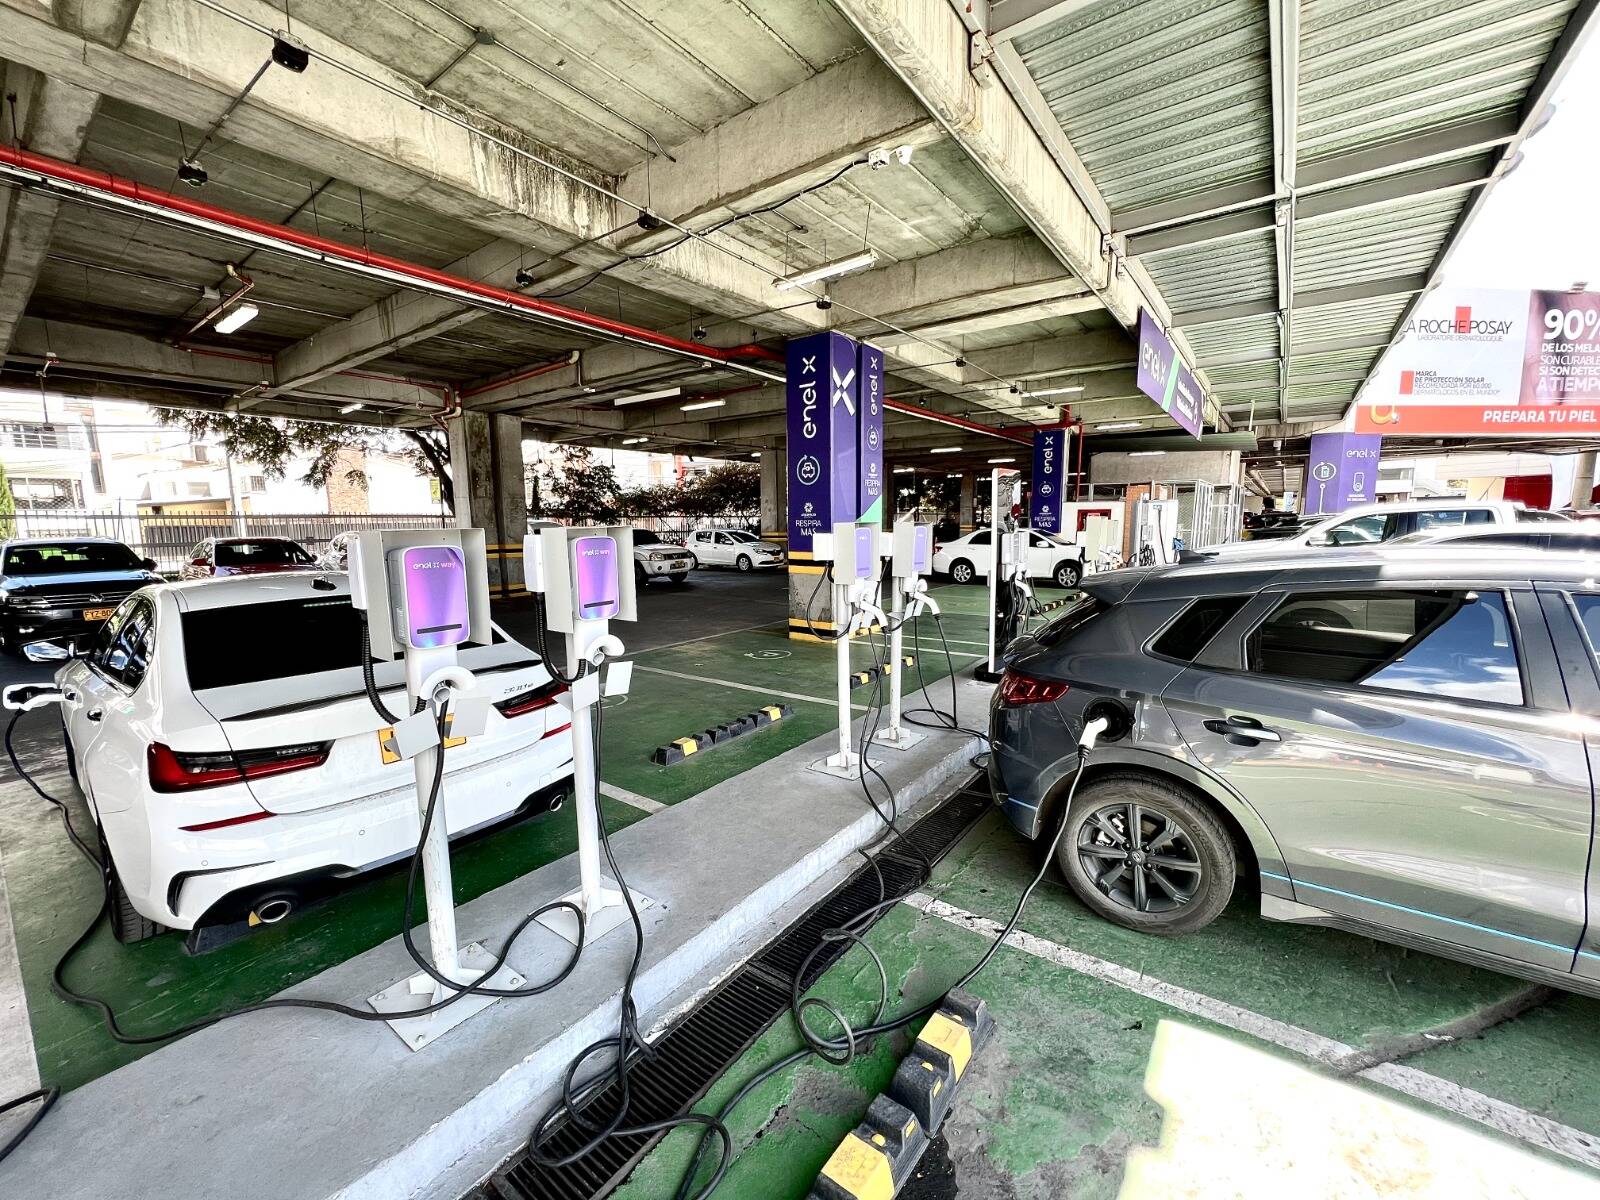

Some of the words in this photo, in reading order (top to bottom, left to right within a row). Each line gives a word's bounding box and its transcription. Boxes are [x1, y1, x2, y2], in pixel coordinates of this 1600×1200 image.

[1419, 320, 1467, 333] ROCHE
[1469, 320, 1512, 334] POSAY
[1543, 309, 1600, 340] 90%
[1541, 343, 1554, 352] DE
[1555, 343, 1574, 352] LOS
[1540, 355, 1560, 364] SON
[1539, 366, 1548, 375] SI
[1550, 366, 1569, 375] SON
[1549, 376, 1600, 392] TIEMP
[869, 374, 878, 416] enel
[799, 381, 816, 439] enel
[1483, 409, 1545, 423] PREPARA
[1548, 409, 1567, 422] TU
[1568, 410, 1597, 422] PIEL
[1346, 448, 1368, 458] enel
[1042, 447, 1053, 474] enel
[413, 562, 431, 570] enel
